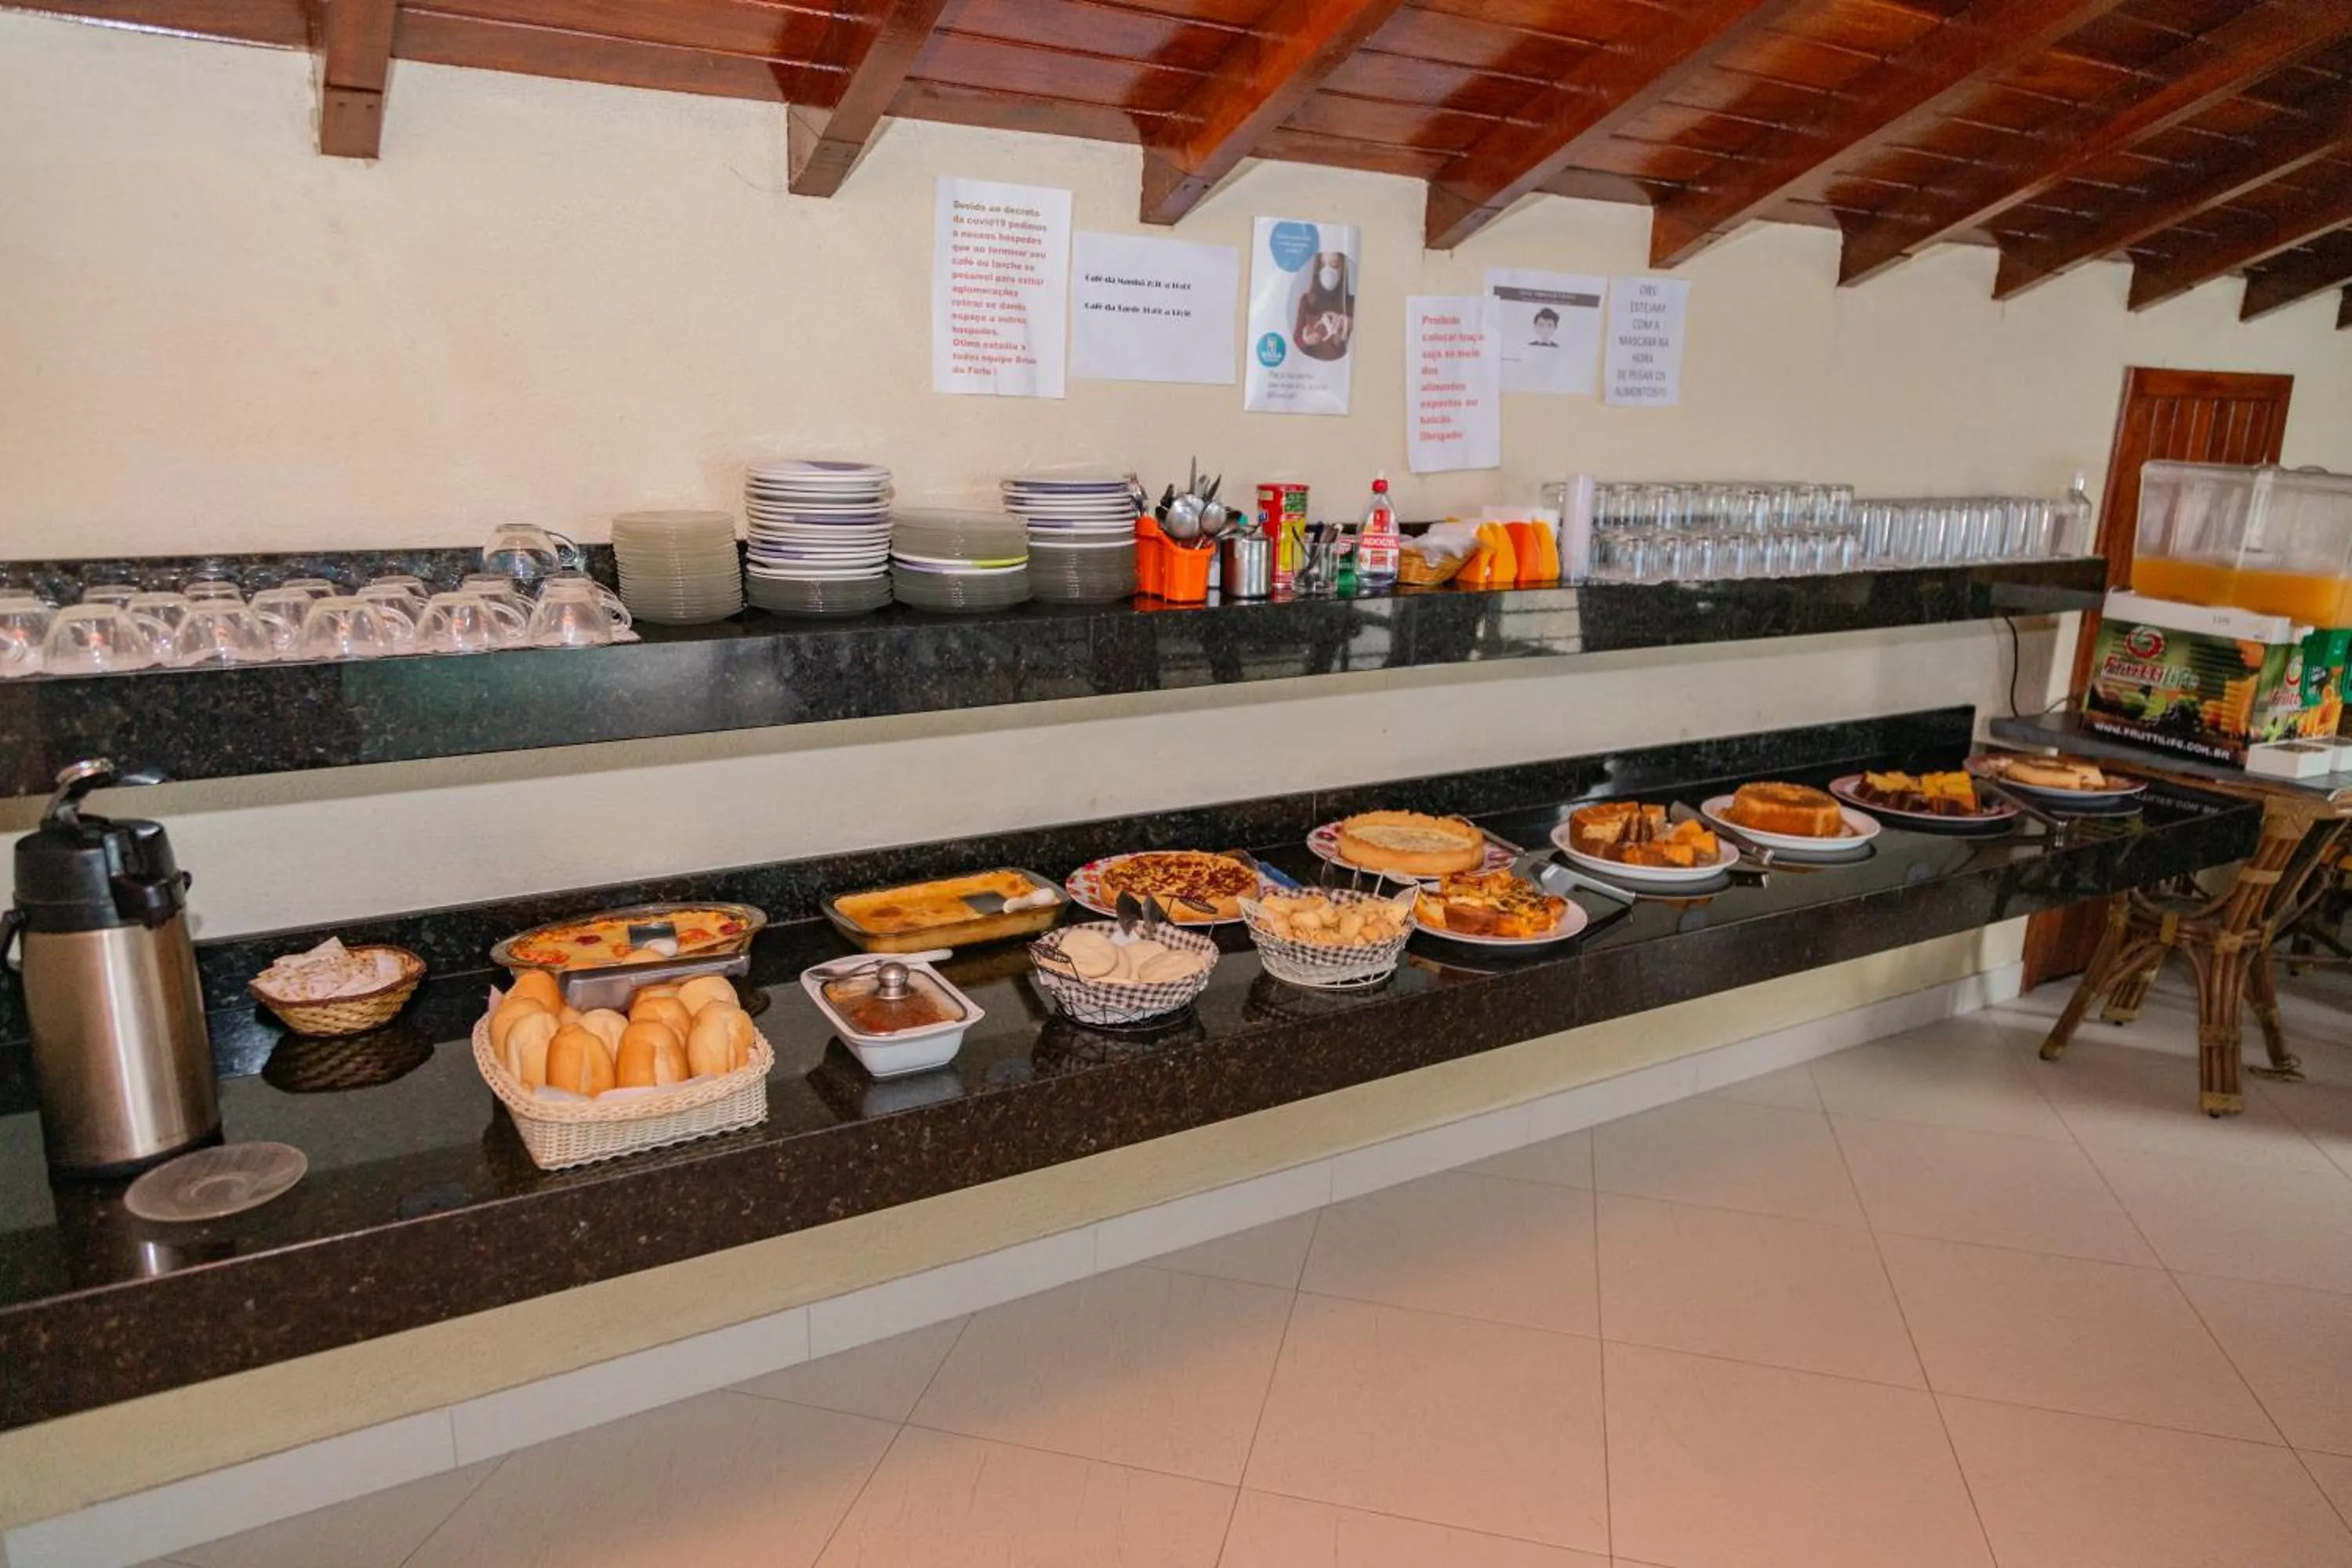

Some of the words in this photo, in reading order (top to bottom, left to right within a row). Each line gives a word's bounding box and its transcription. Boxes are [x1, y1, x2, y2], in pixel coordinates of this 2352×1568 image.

[953, 201, 985, 211] Devido
[1004, 205, 1040, 216] decreto
[1008, 221, 1047, 232] pedimos
